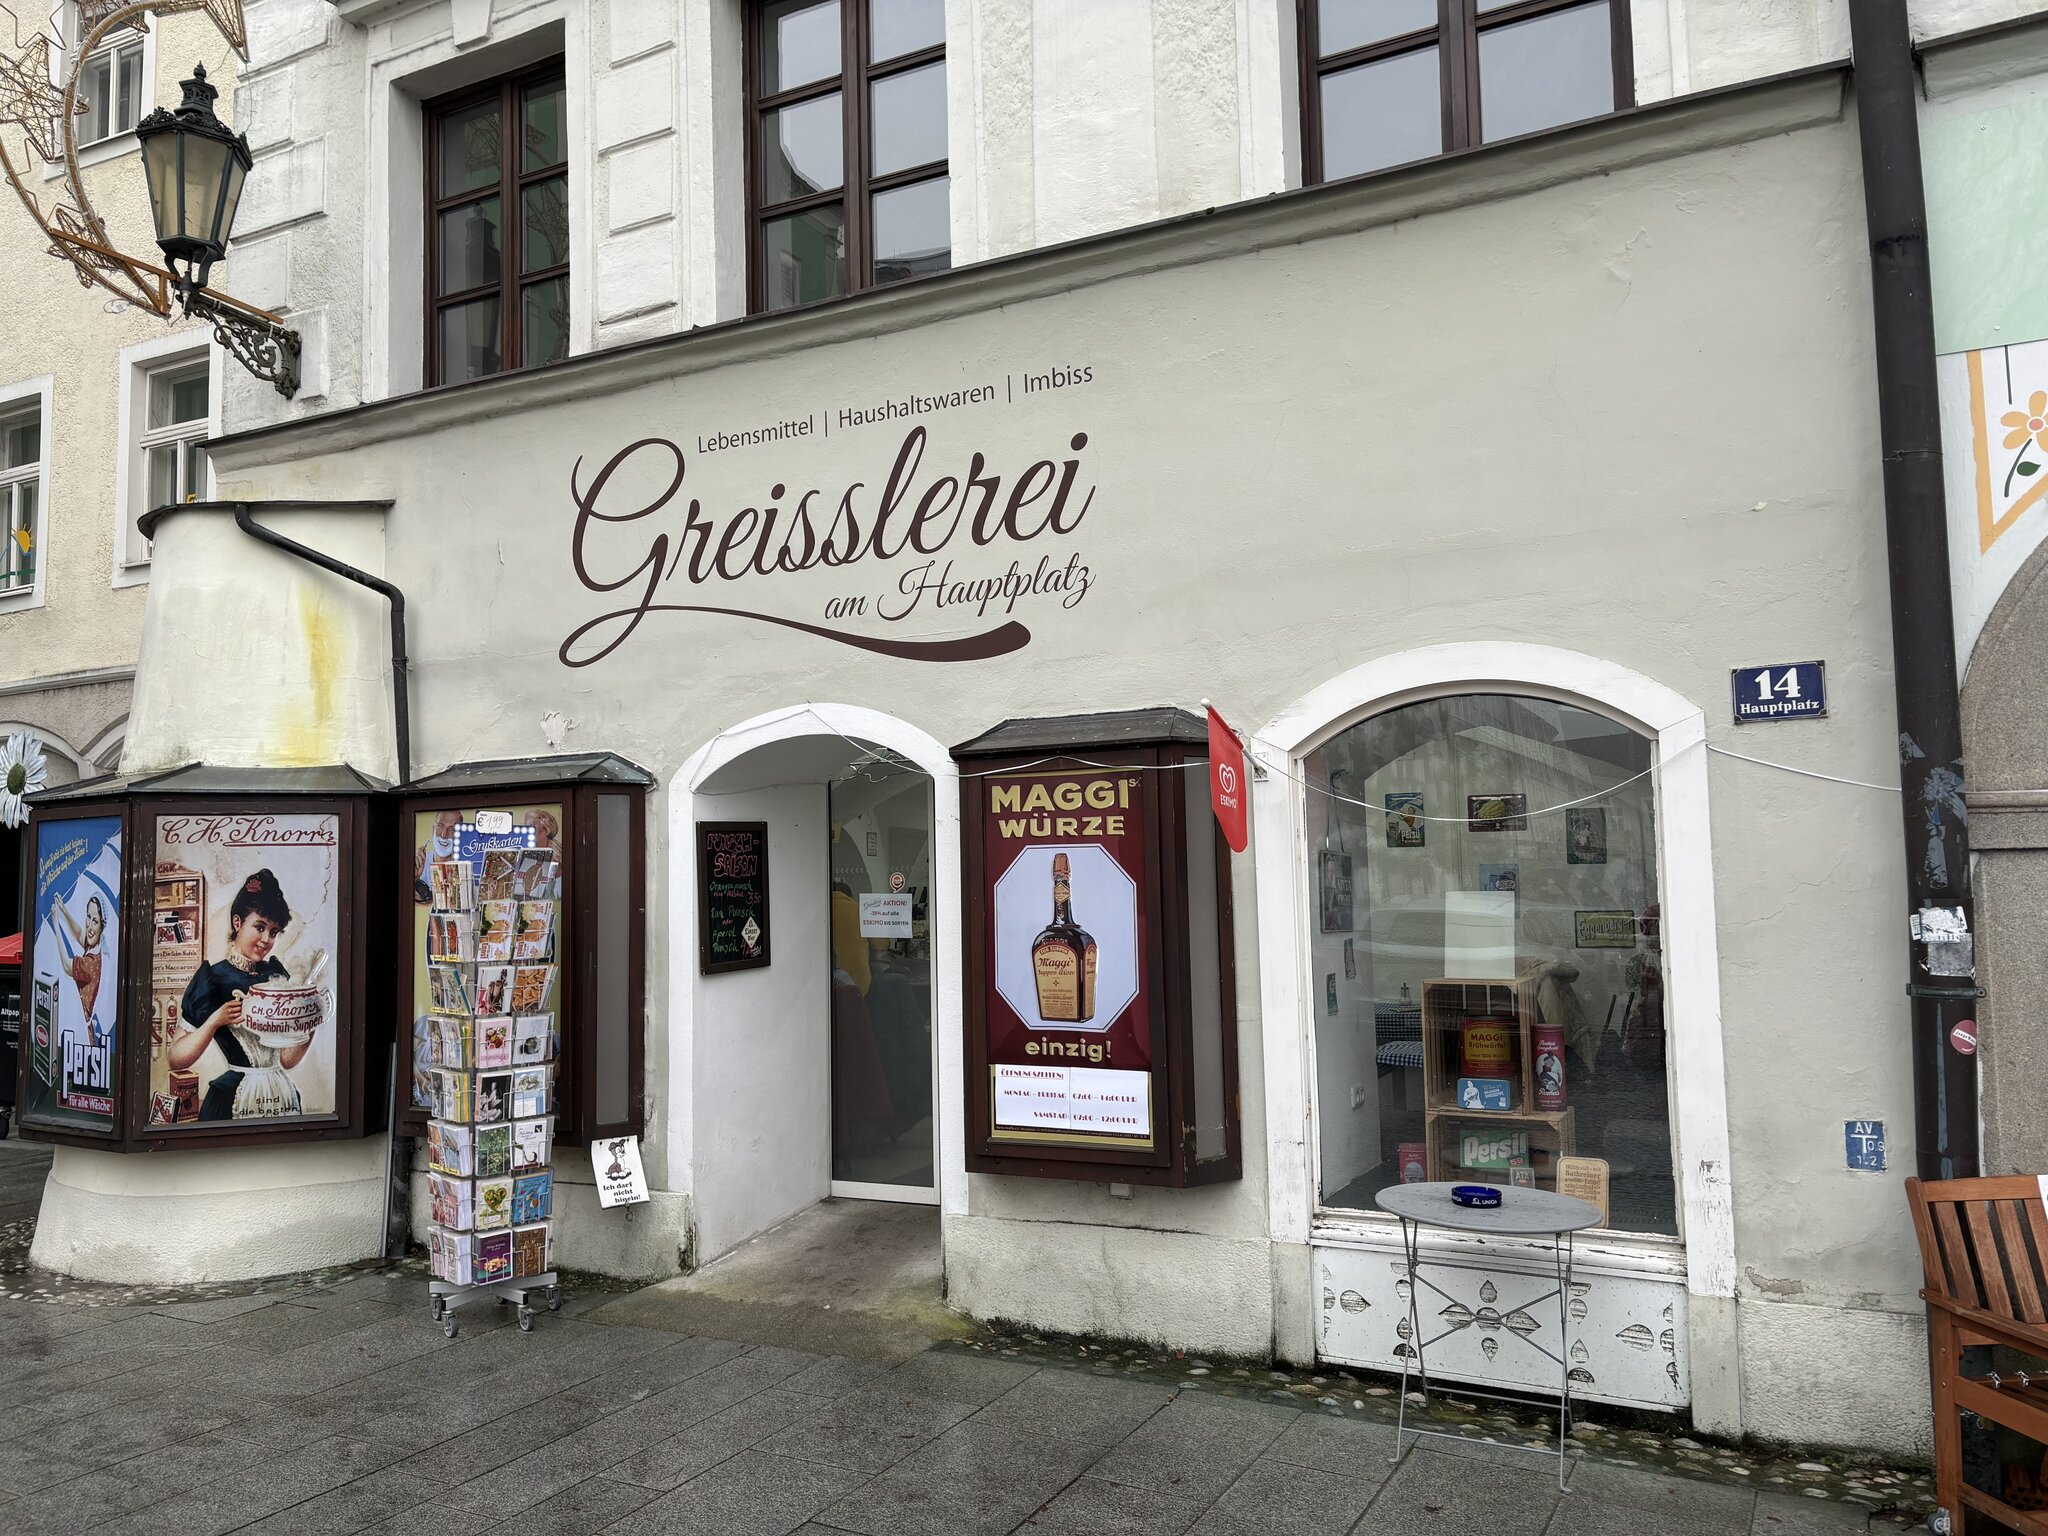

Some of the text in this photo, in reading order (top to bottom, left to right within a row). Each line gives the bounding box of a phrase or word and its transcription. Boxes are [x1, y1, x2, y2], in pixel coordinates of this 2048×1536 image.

[697, 415, 815, 455] Lebensmittel
[838, 384, 996, 429] Haushaltswaren
[1022, 365, 1094, 395] Imbiss
[559, 425, 1097, 668] Greisslerei
[824, 551, 1097, 622] am Hauptplatz
[1754, 667, 1802, 700] 14
[1740, 699, 1820, 716] Hauptplatz
[1220, 794, 1237, 808] ESKIMO
[998, 812, 1126, 839] WÜRZE
[713, 852, 758, 878] SAISON
[1470, 1033, 1504, 1042] MAGGI
[1024, 1036, 1113, 1063] einzig!
[62, 1030, 112, 1100] Persil
[77, 1096, 89, 1109] alle
[255, 1095, 280, 1105] sind
[1033, 1111, 1068, 1120] SAMSTAG
[1854, 1121, 1873, 1135] AV
[1463, 1131, 1527, 1167] Persil
[613, 1189, 634, 1197] nicht
[621, 1181, 633, 1189] darf
